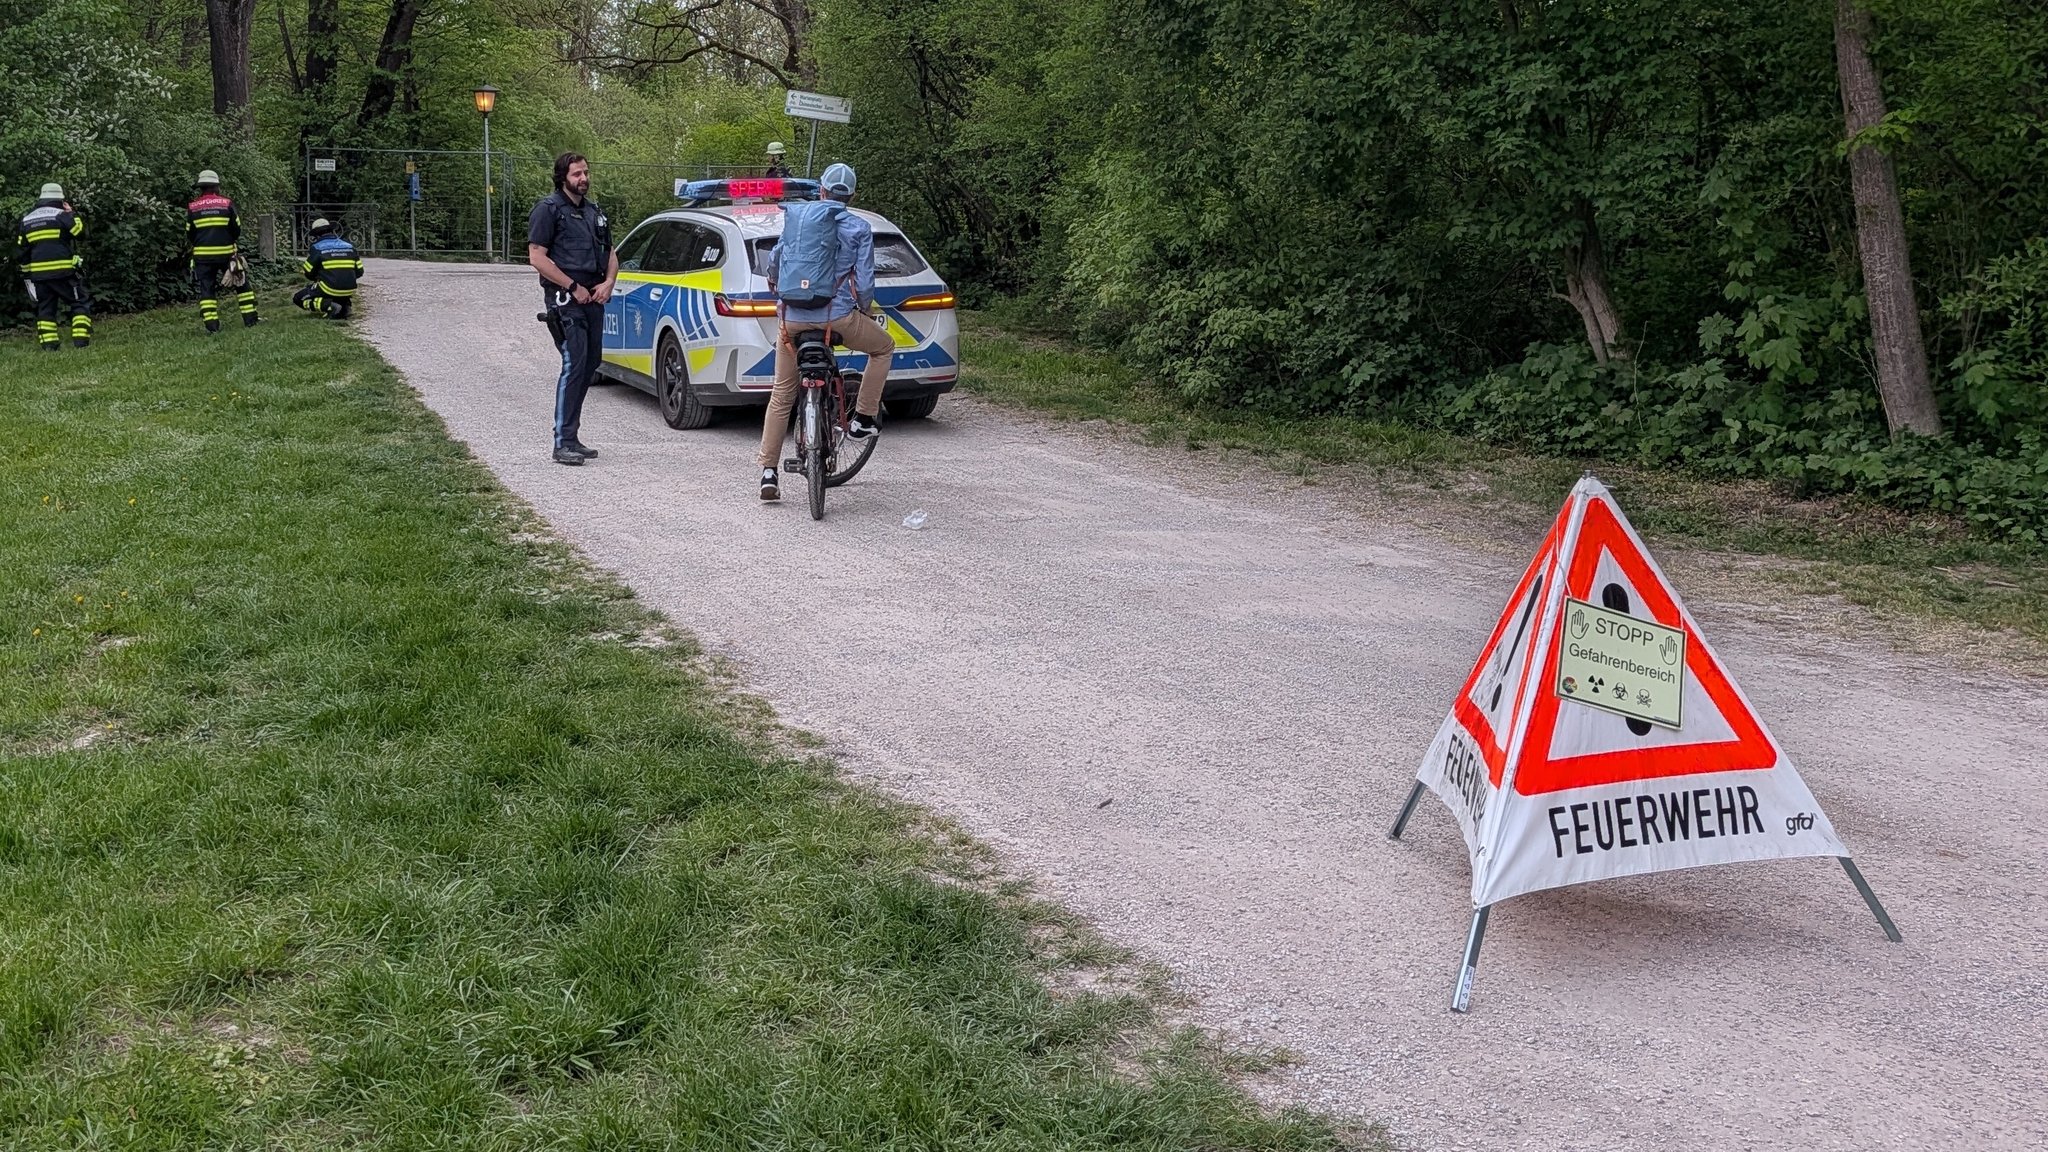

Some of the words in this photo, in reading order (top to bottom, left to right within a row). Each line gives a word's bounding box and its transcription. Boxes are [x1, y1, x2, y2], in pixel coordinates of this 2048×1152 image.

[729, 180, 784, 197] SPER
[1595, 617, 1654, 646] STOPP
[1569, 643, 1676, 684] Gefahrenbereich
[1548, 785, 1765, 858] FEUERWEHR
